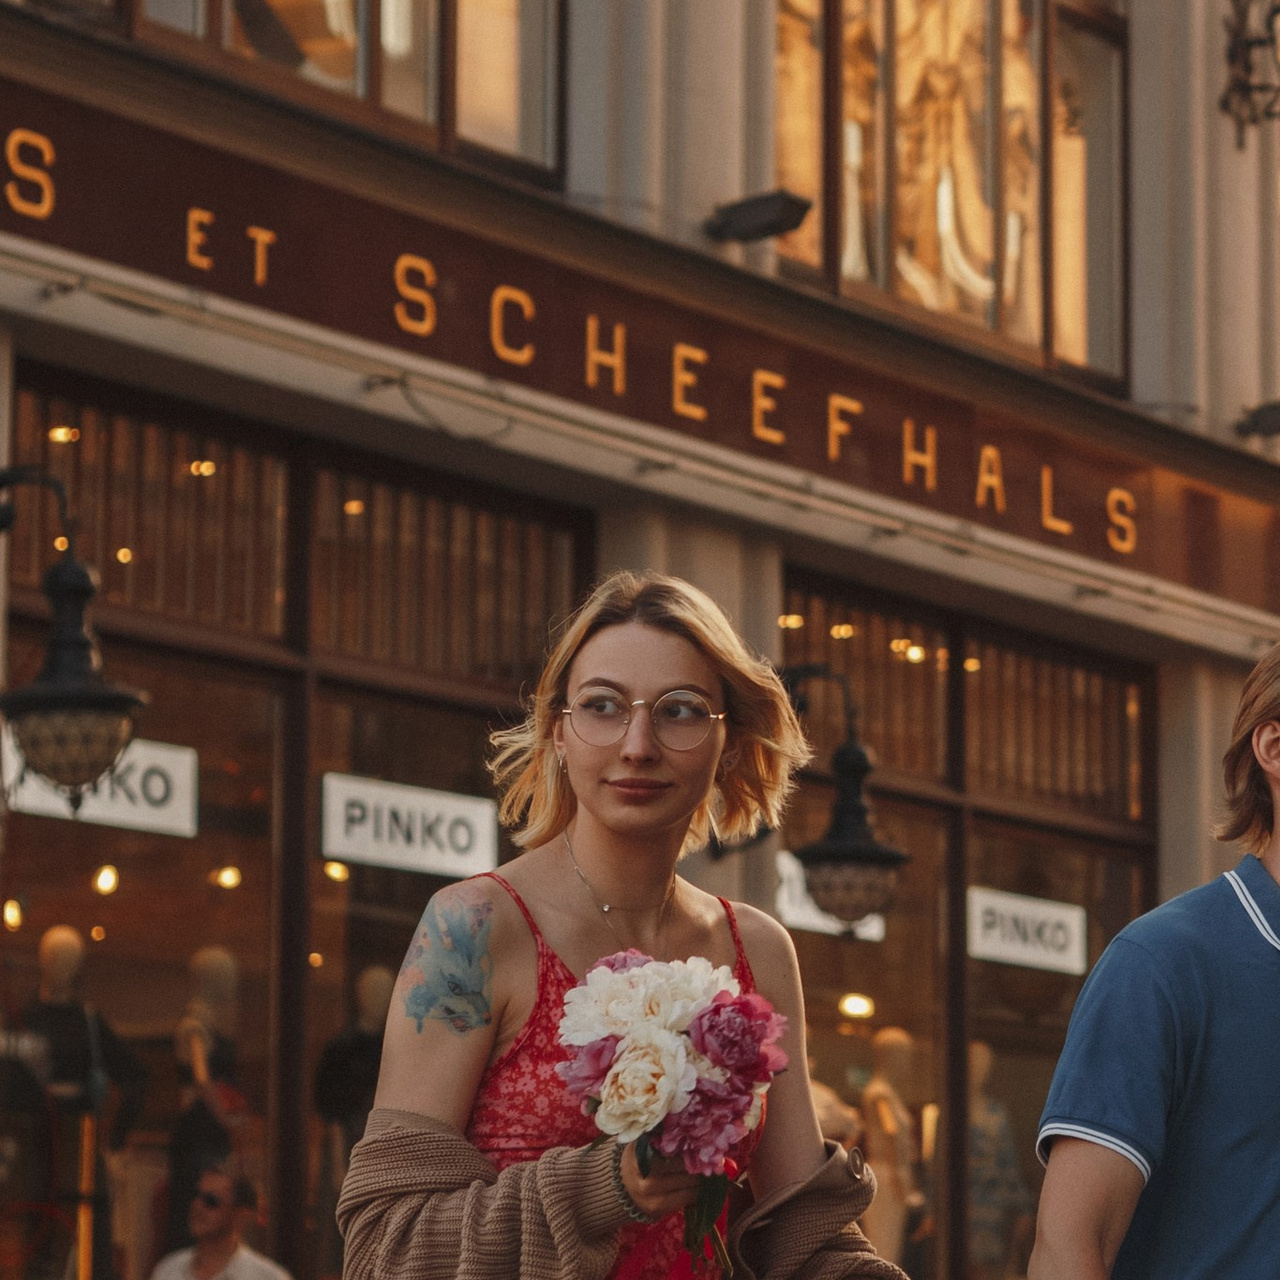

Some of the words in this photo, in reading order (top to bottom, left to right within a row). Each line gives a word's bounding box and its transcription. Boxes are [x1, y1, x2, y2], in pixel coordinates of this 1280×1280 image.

[187, 206, 277, 287] ET
[394, 254, 1138, 554] SCHEEFHALS
[344, 799, 476, 854] PINKO
[982, 906, 1073, 953] PINKO
